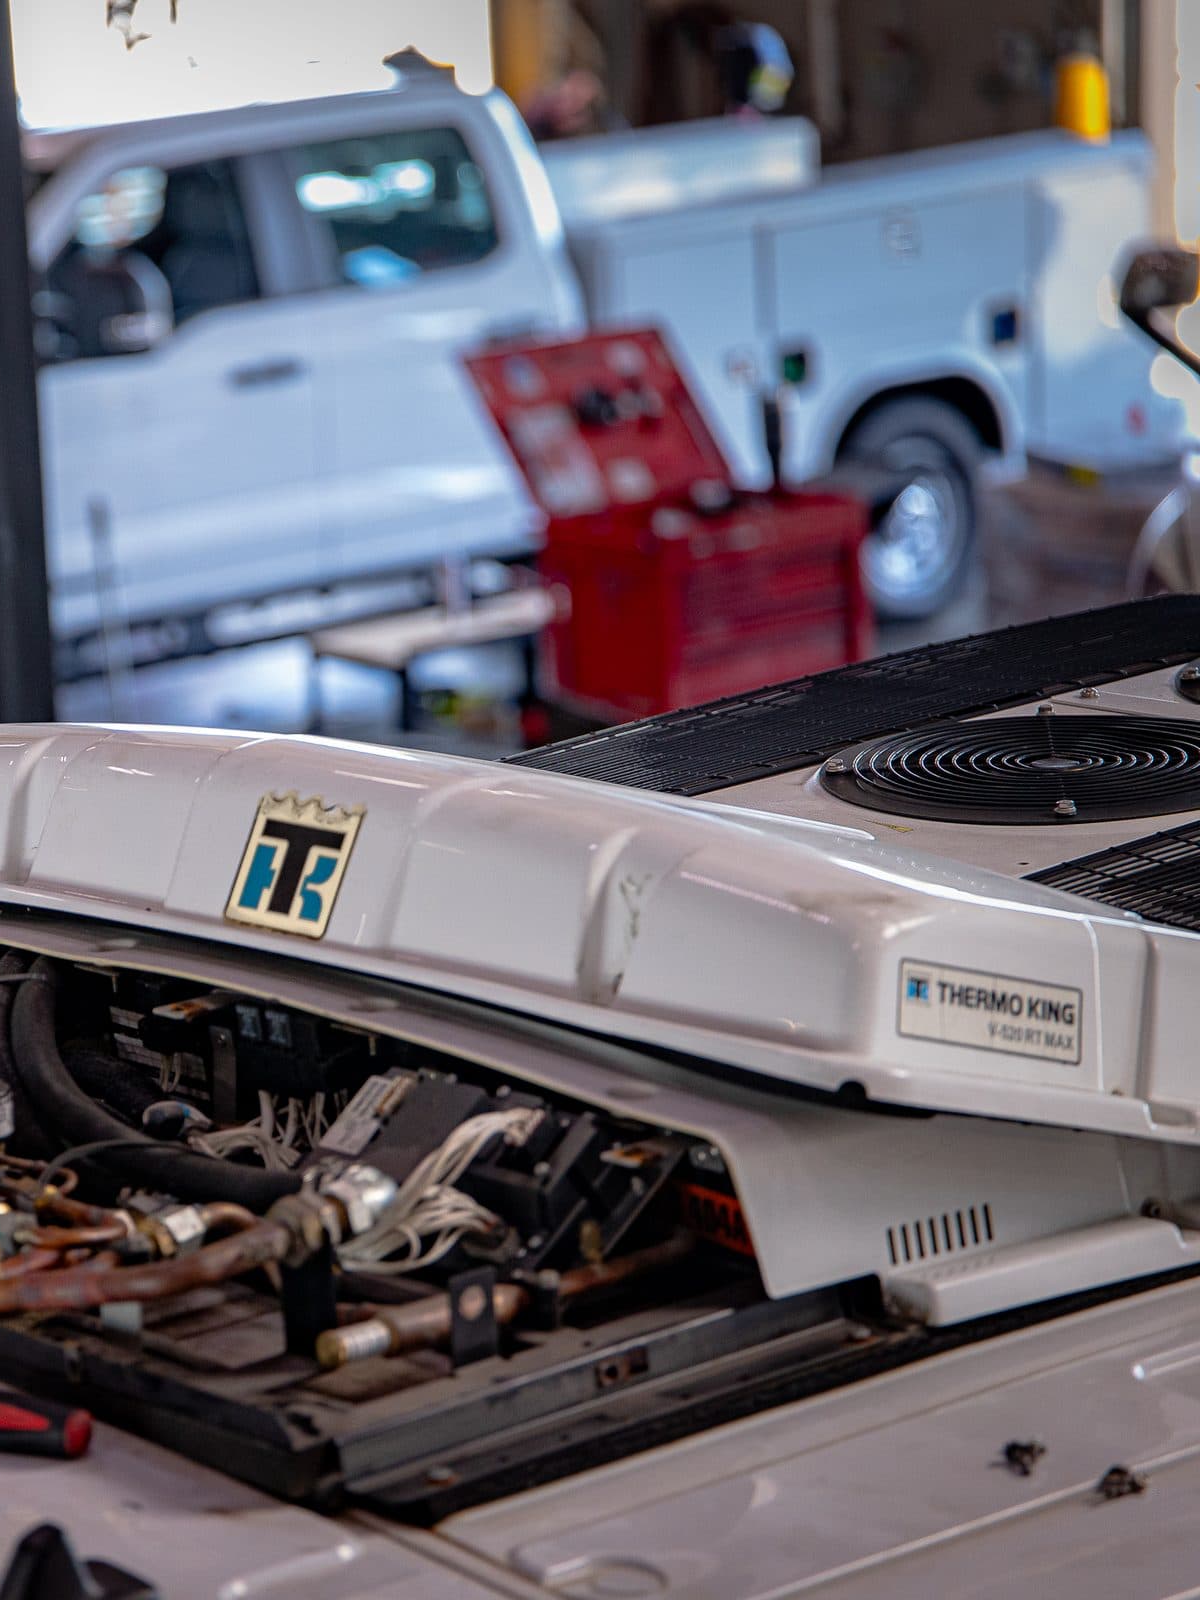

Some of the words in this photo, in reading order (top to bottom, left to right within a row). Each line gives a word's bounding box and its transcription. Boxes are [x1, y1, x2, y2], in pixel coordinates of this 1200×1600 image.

[936, 981, 1024, 1016] THERMO
[1027, 996, 1075, 1026] KING
[1024, 1027, 1041, 1045] RT
[1044, 1032, 1074, 1050] MAX
